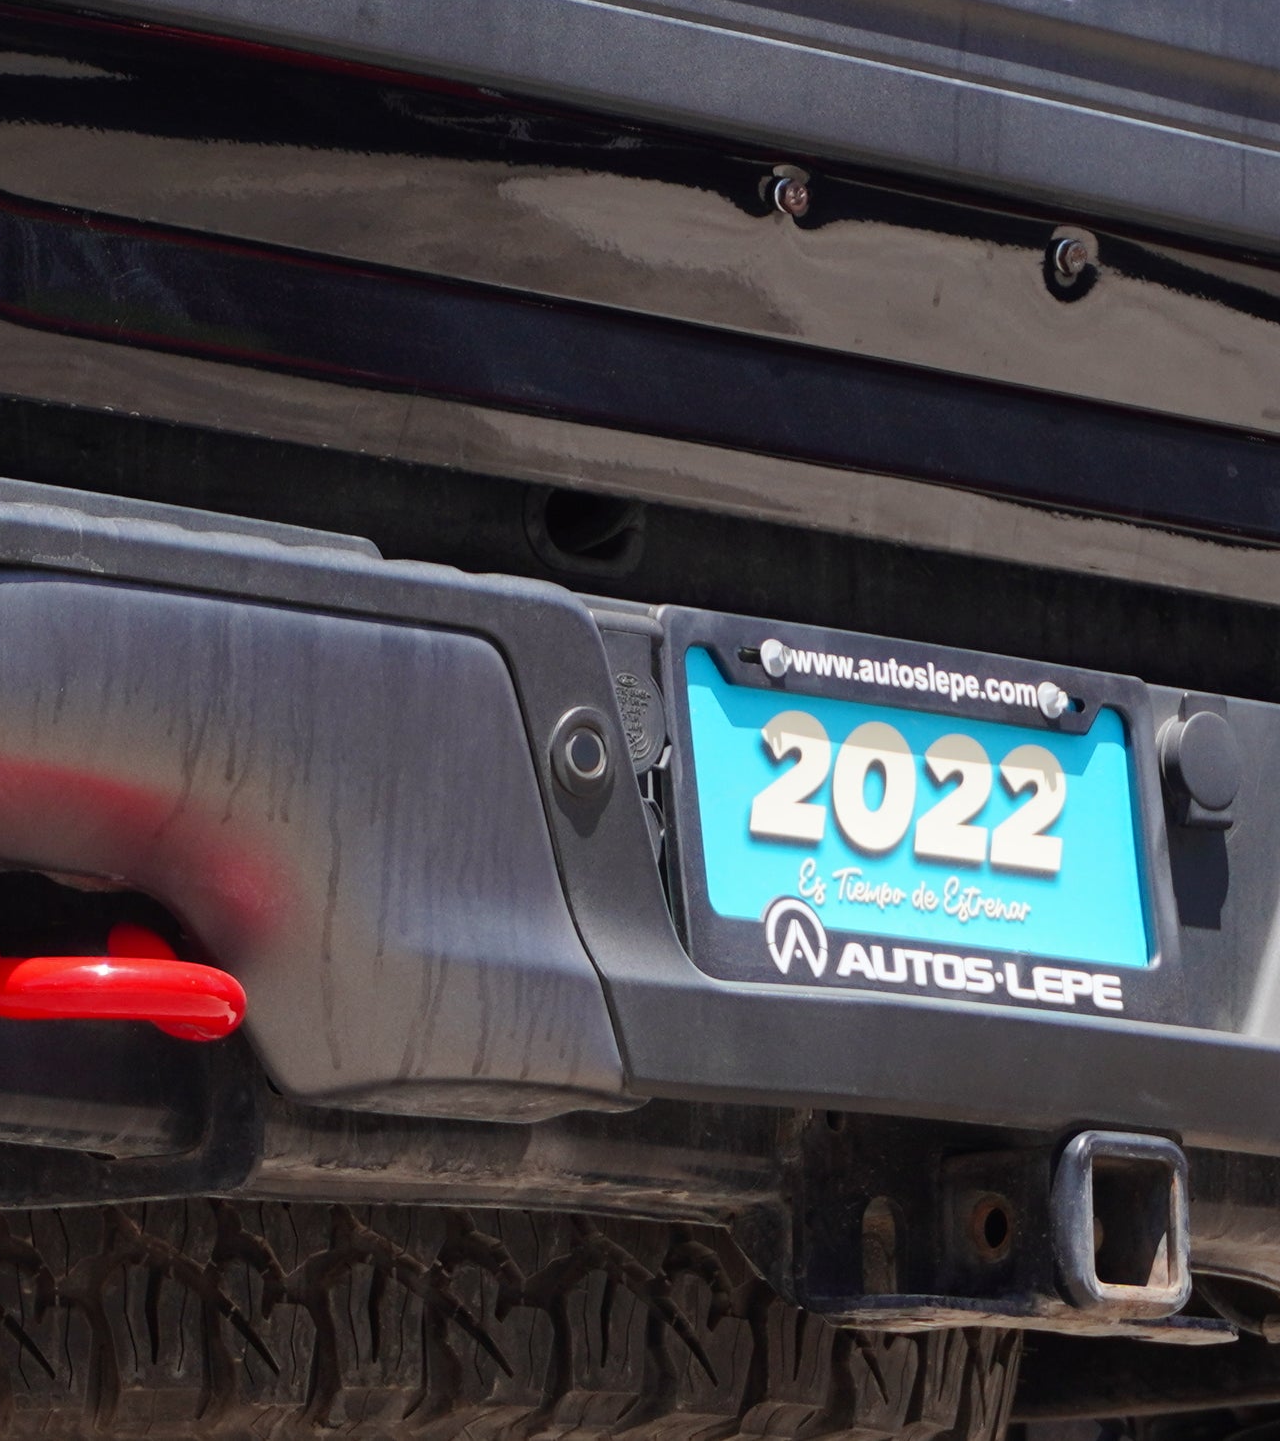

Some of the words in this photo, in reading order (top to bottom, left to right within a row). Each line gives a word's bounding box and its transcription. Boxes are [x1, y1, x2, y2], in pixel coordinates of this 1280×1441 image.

[791, 648, 1039, 703] www.autoslepe.com
[749, 710, 1067, 874] 2022
[798, 858, 827, 905] Es
[832, 867, 907, 910] Tiempo
[912, 881, 939, 911] de
[943, 876, 1032, 923] Estrenar
